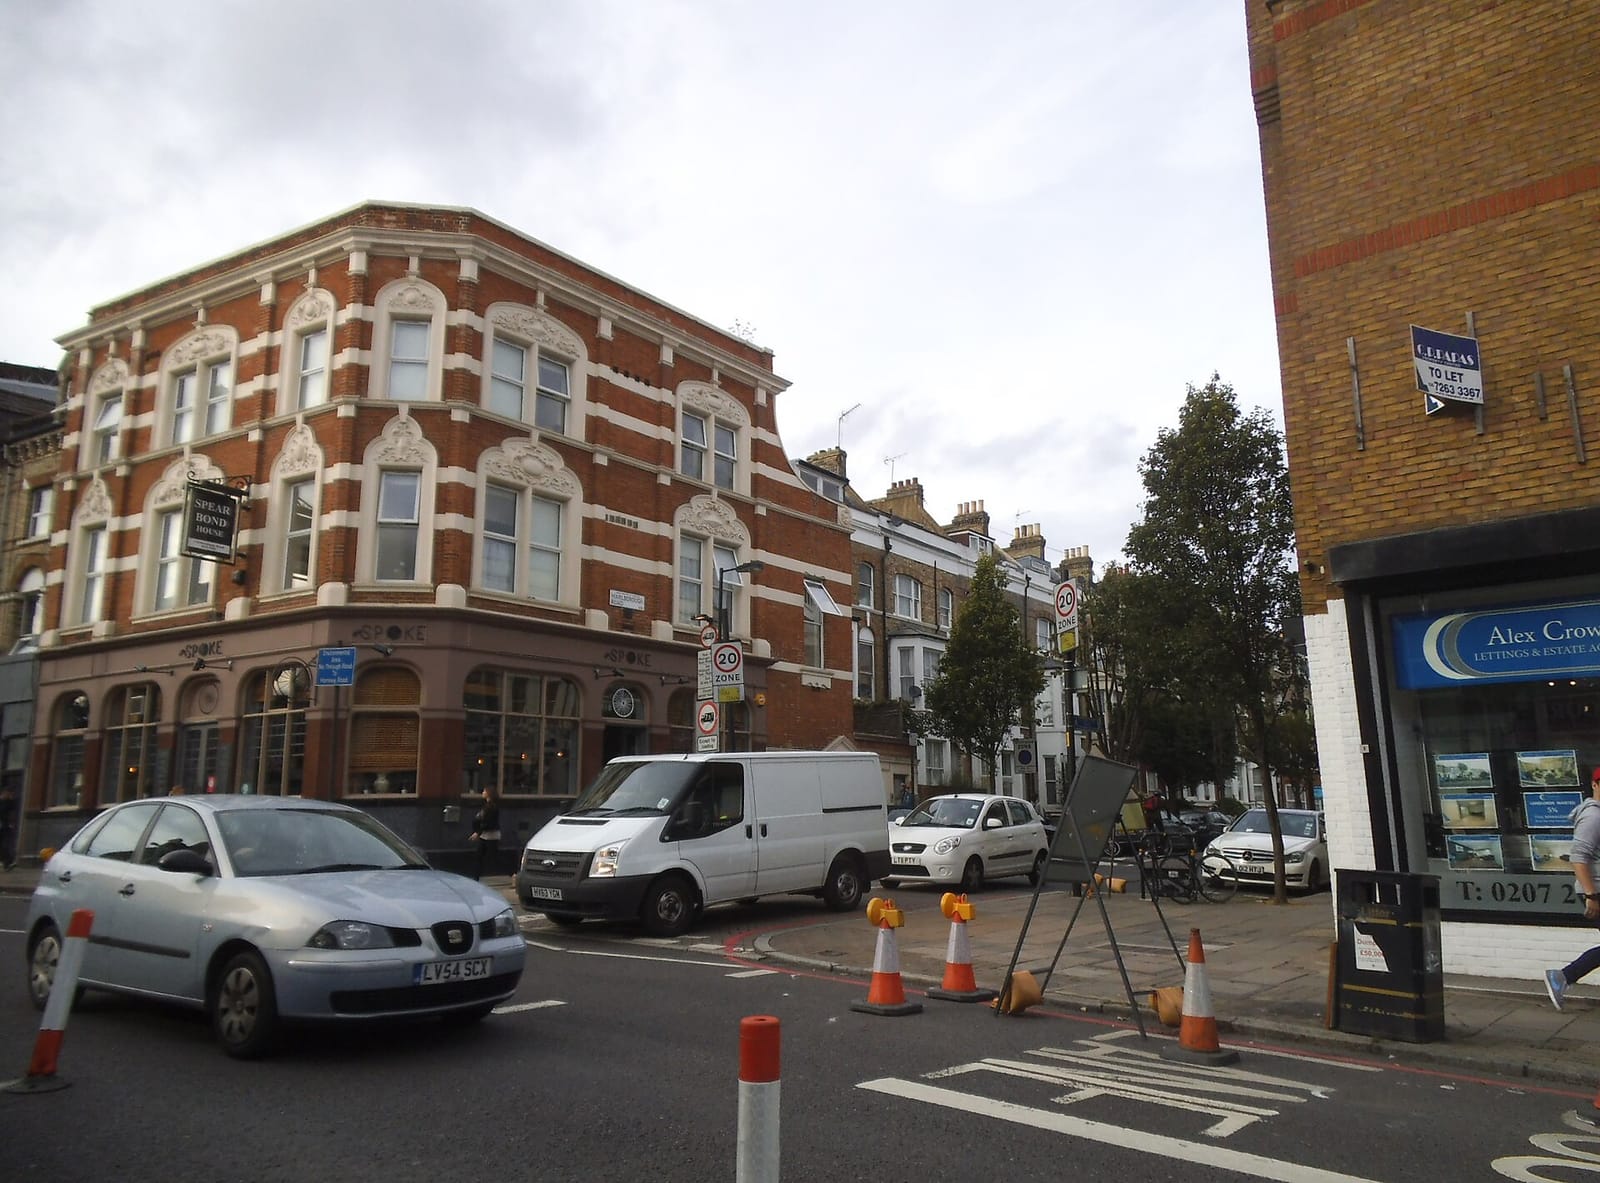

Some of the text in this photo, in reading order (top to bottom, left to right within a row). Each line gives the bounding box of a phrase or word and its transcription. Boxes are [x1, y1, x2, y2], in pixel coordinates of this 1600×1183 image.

[1428, 366, 1464, 383] TO LET
[1433, 381, 1455, 395] 7263
[1457, 386, 1480, 398] 3367
[195, 499, 231, 515] SPEAR
[196, 512, 227, 528] BOND
[196, 525, 224, 538] HOUSE
[1059, 591, 1073, 609] 20
[1058, 615, 1077, 630] ZONE
[1487, 626, 1537, 646] Alex
[718, 652, 737, 665] 20
[1474, 648, 1529, 662] LETTINGS
[1532, 647, 1541, 658] &
[1543, 644, 1586, 656] ESTATE
[715, 674, 741, 683] ZONE
[1456, 881, 1581, 904] T: 0207 2
[423, 960, 488, 981] LV54 SCX
